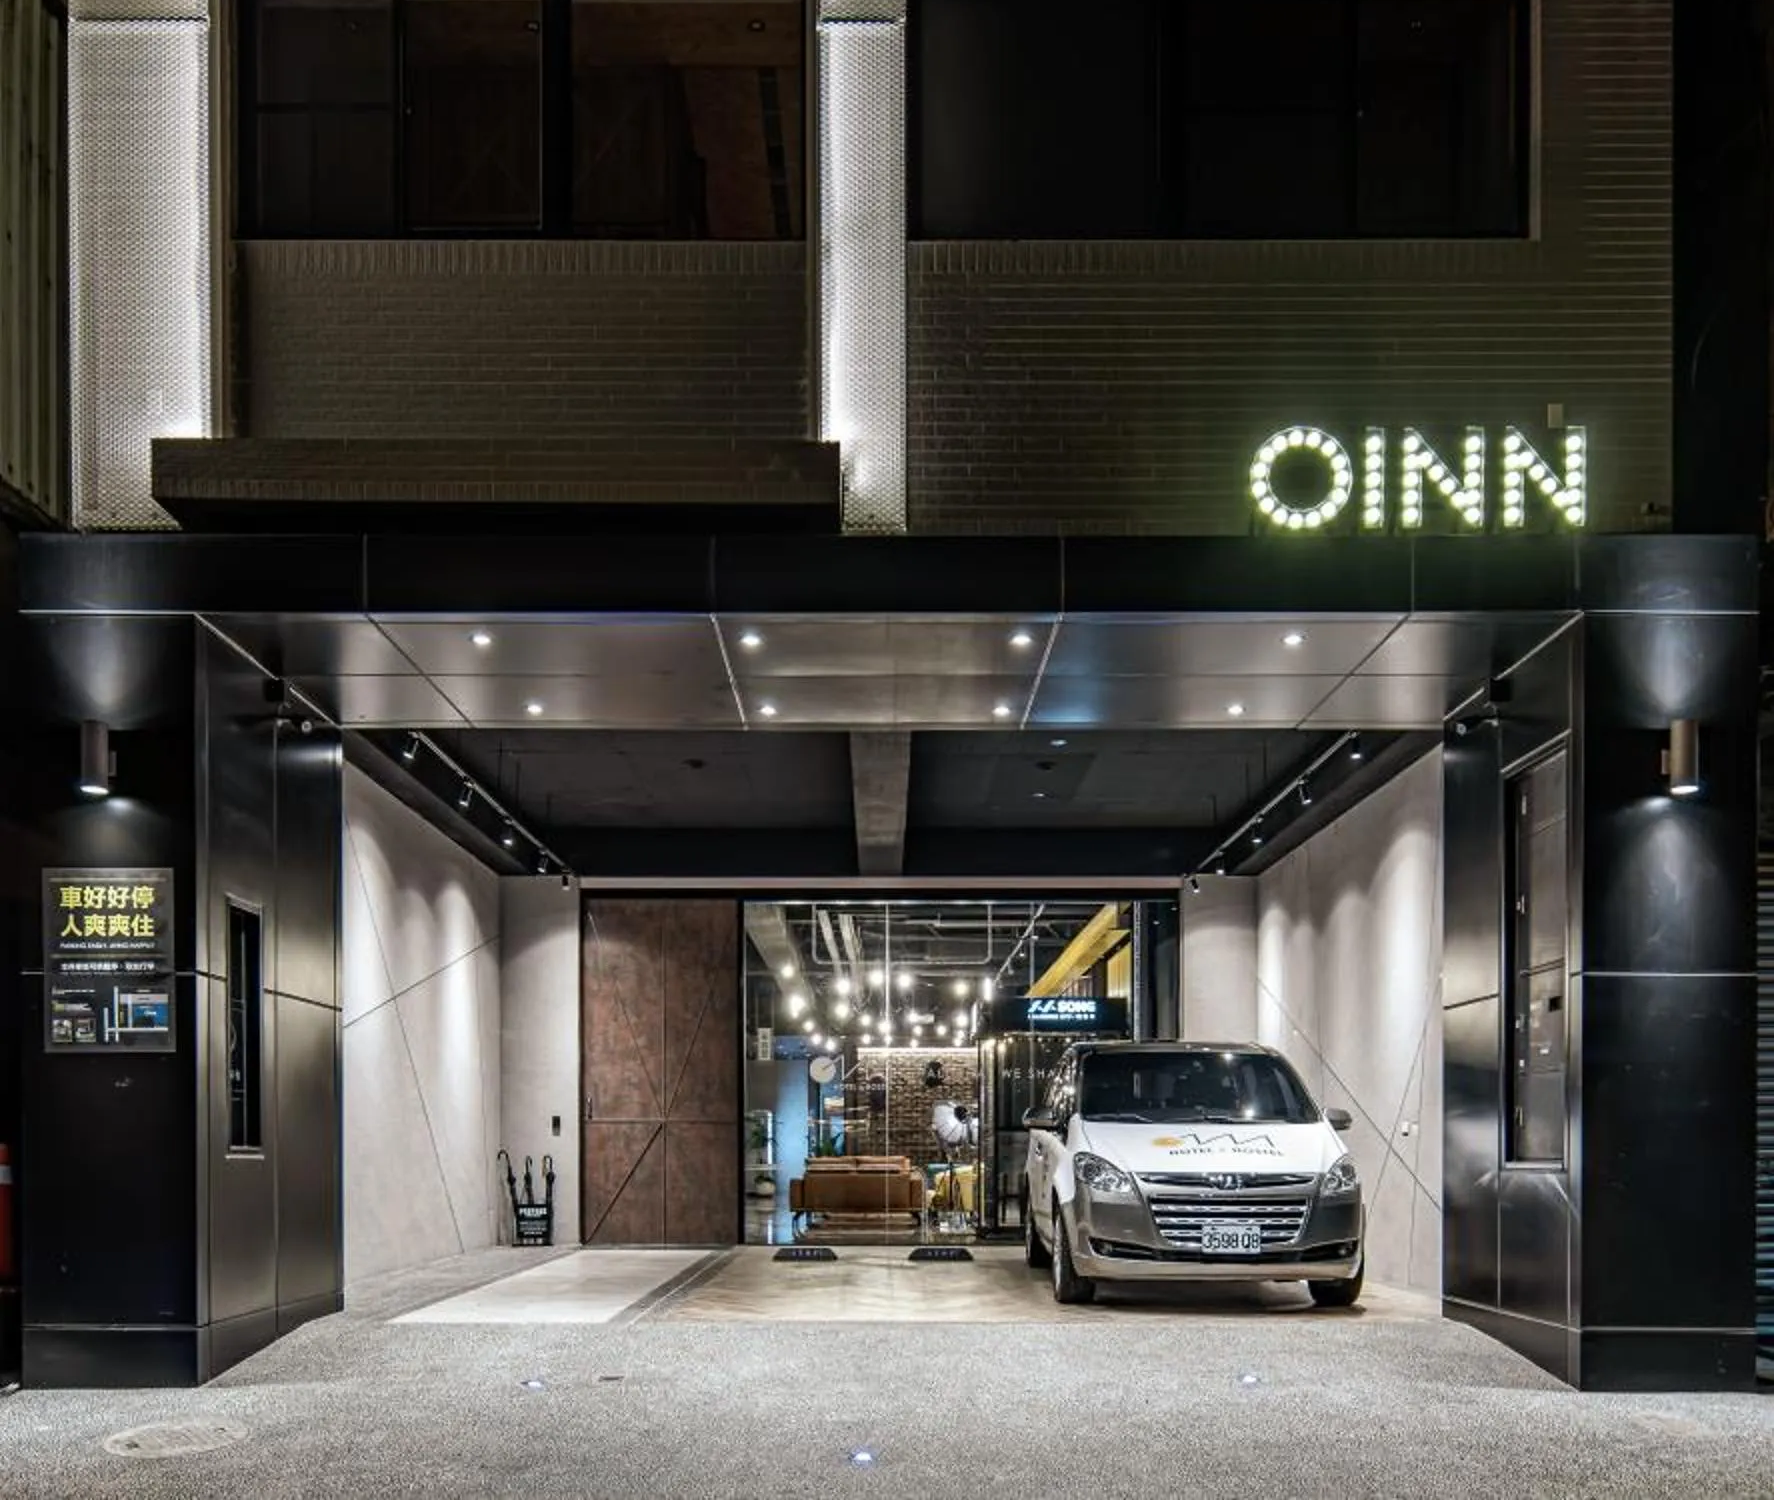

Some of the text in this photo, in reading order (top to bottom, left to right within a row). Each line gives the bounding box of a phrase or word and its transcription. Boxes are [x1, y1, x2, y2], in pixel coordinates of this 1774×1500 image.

[1250, 425, 1586, 529] OINN
[59, 886, 155, 909] 車好好停
[61, 914, 155, 937] 人爽爽住
